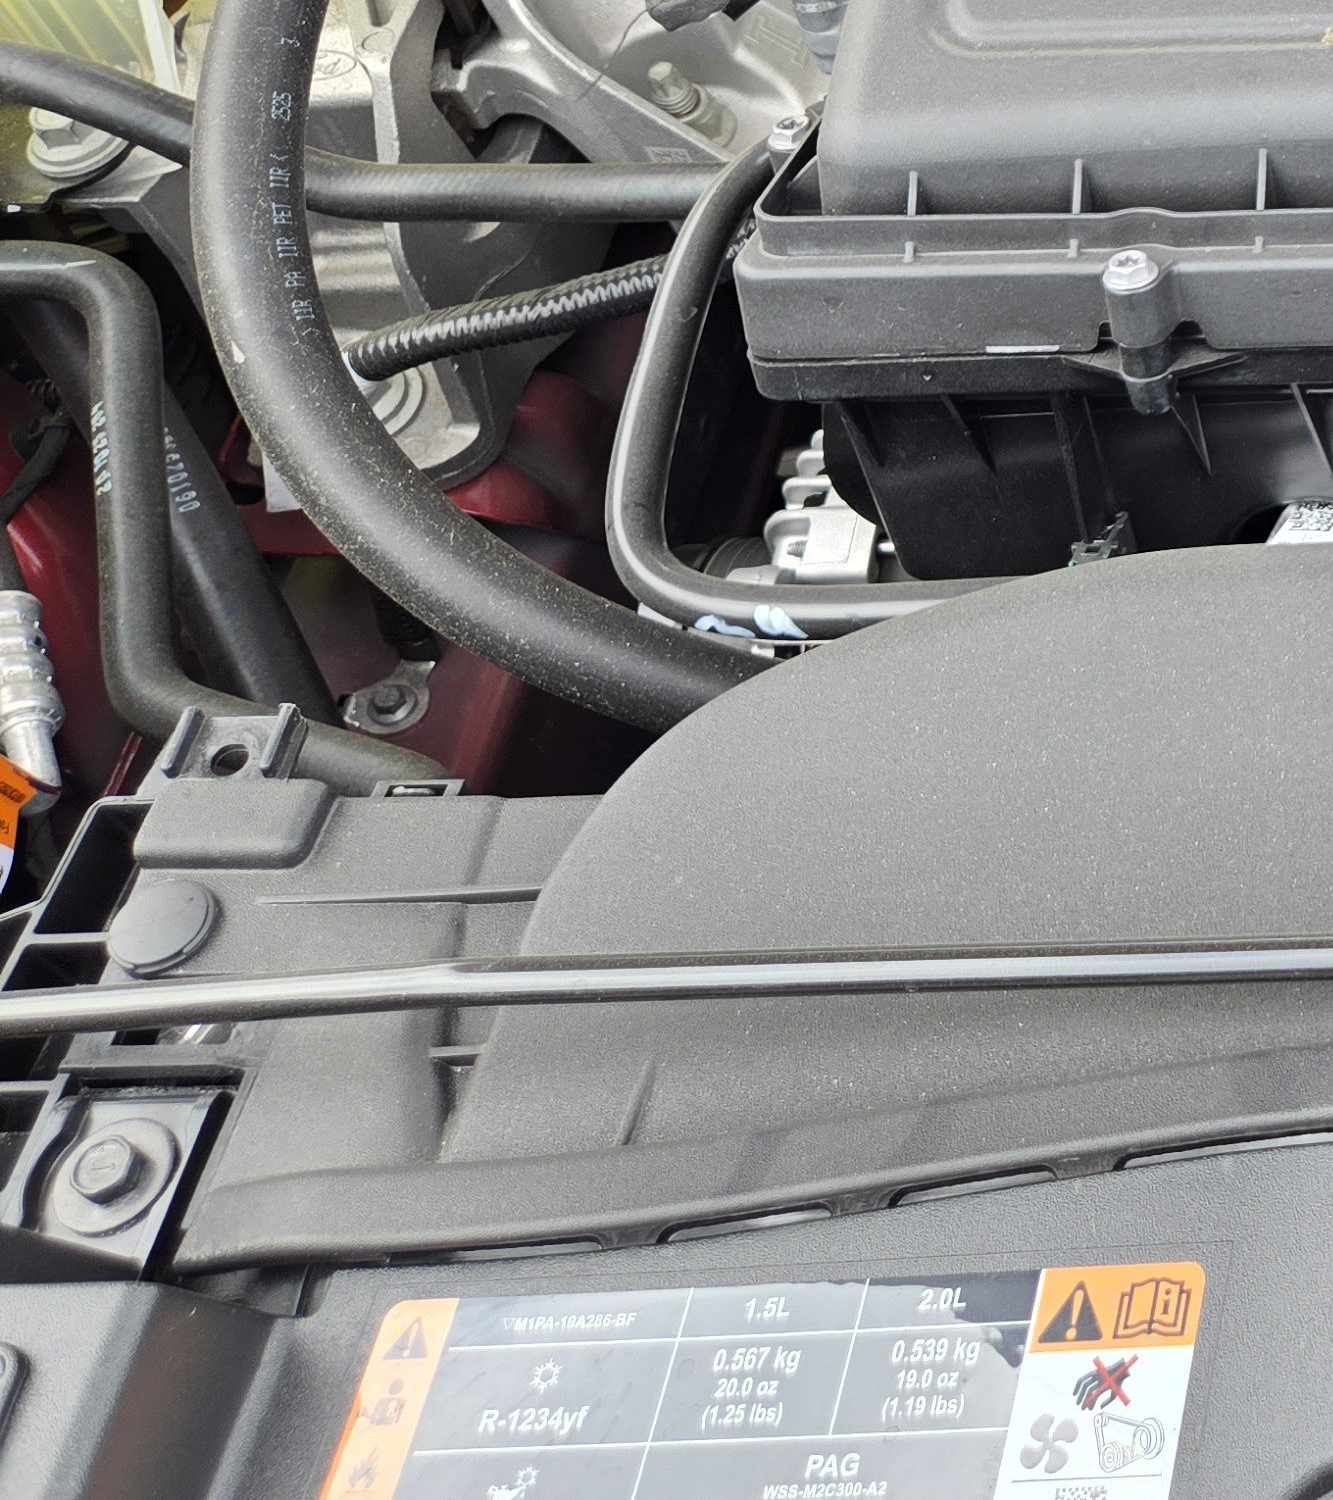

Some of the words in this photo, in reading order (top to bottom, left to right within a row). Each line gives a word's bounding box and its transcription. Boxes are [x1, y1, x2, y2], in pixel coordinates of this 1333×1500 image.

[268, 200, 295, 226] PET
[745, 1297, 790, 1321] 1.5L
[917, 1287, 967, 1311] 2.0L
[713, 1347, 769, 1373] 0.567
[773, 1347, 801, 1375] kg
[890, 1337, 948, 1363] 0.539
[953, 1337, 982, 1365] kg
[713, 1378, 754, 1398] 20.0
[757, 1379, 778, 1396] oz
[896, 1372, 934, 1390] 19.0
[937, 1372, 959, 1389] oz
[478, 1404, 589, 1435] R-1234yf
[701, 1405, 746, 1429] (1.25
[748, 1402, 784, 1426] lbs)
[881, 1399, 928, 1422] (1.19
[929, 1396, 965, 1419] lbs)
[804, 1452, 861, 1479] PAG
[763, 1480, 888, 1500] WSS-M2C300-A2
